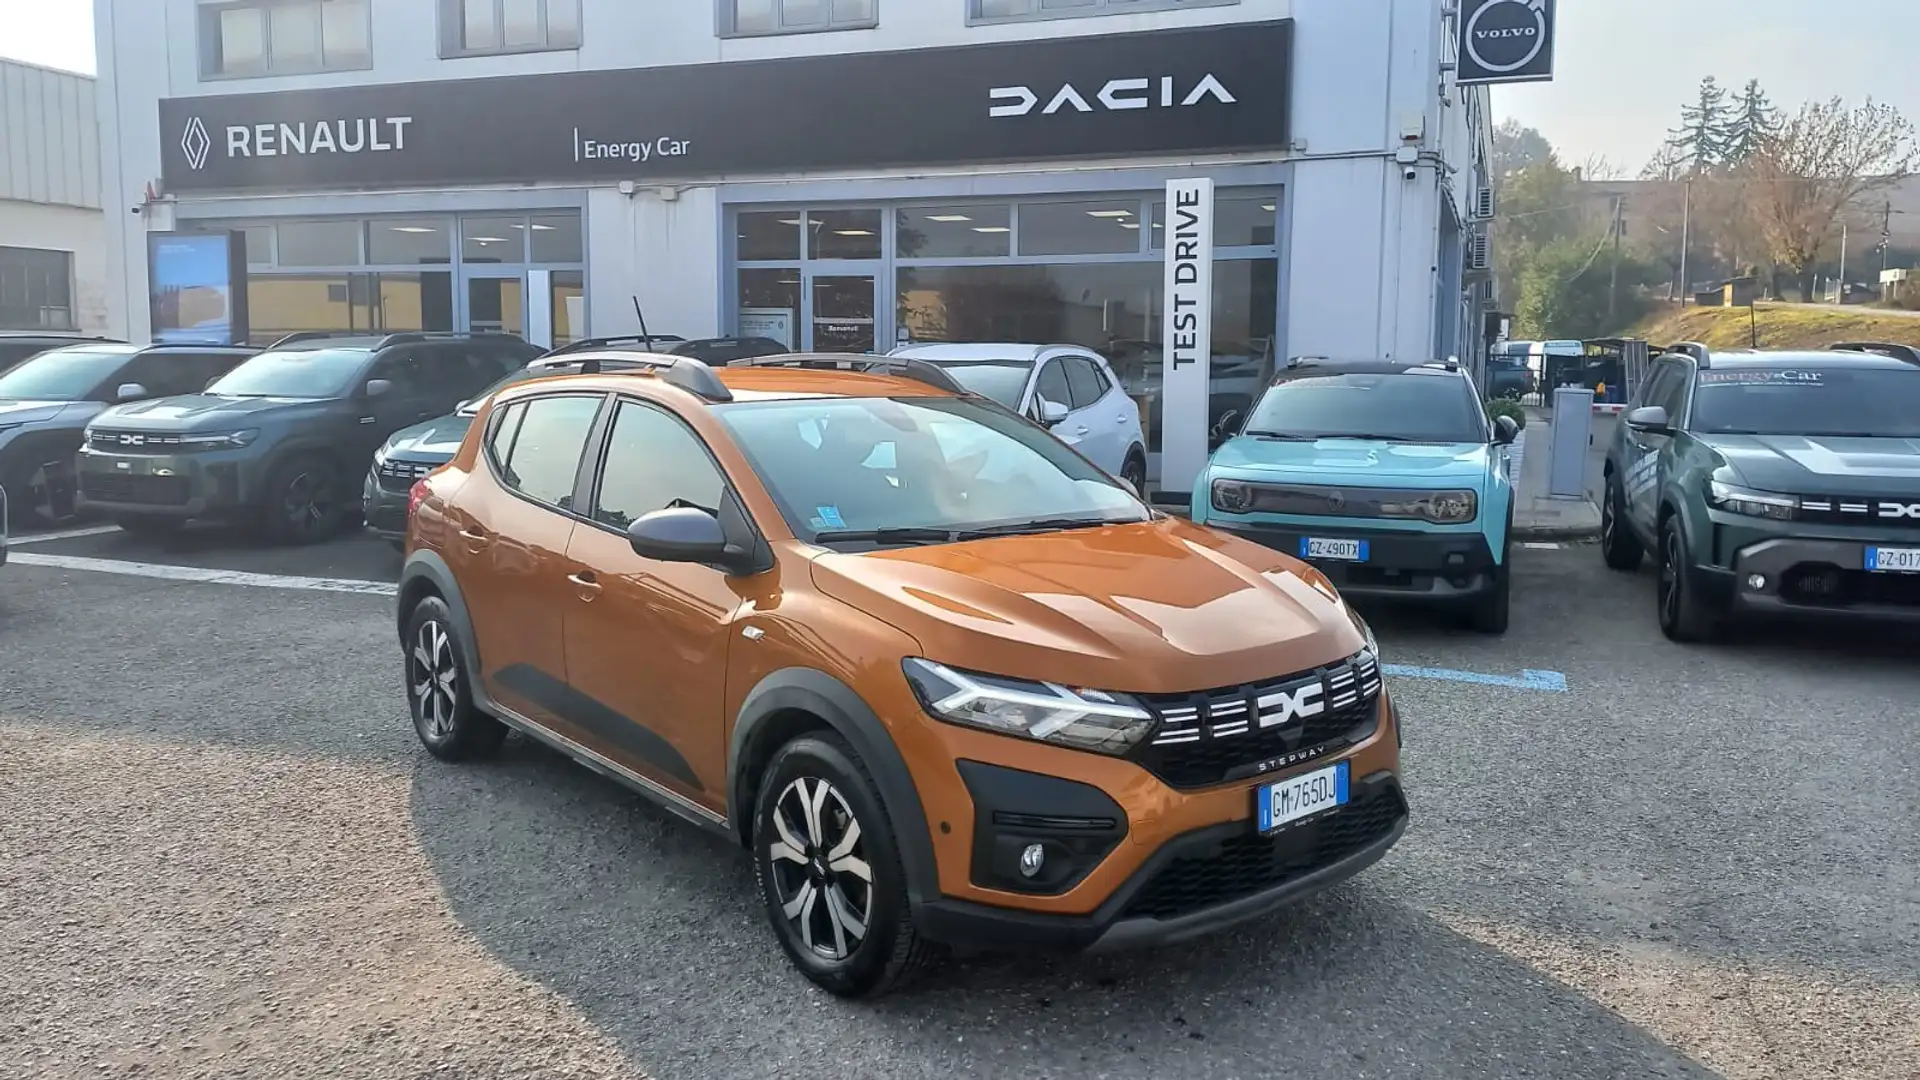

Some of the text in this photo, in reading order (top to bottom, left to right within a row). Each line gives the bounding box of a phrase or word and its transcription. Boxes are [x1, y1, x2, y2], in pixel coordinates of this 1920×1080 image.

[1475, 27, 1535, 38] VOLVO
[989, 73, 1237, 117] DACIA
[226, 116, 412, 157] RENAULT
[584, 137, 690, 162] Energy Car
[1173, 189, 1199, 370] TEST DRIVE
[1258, 745, 1324, 771] STEPWAY
